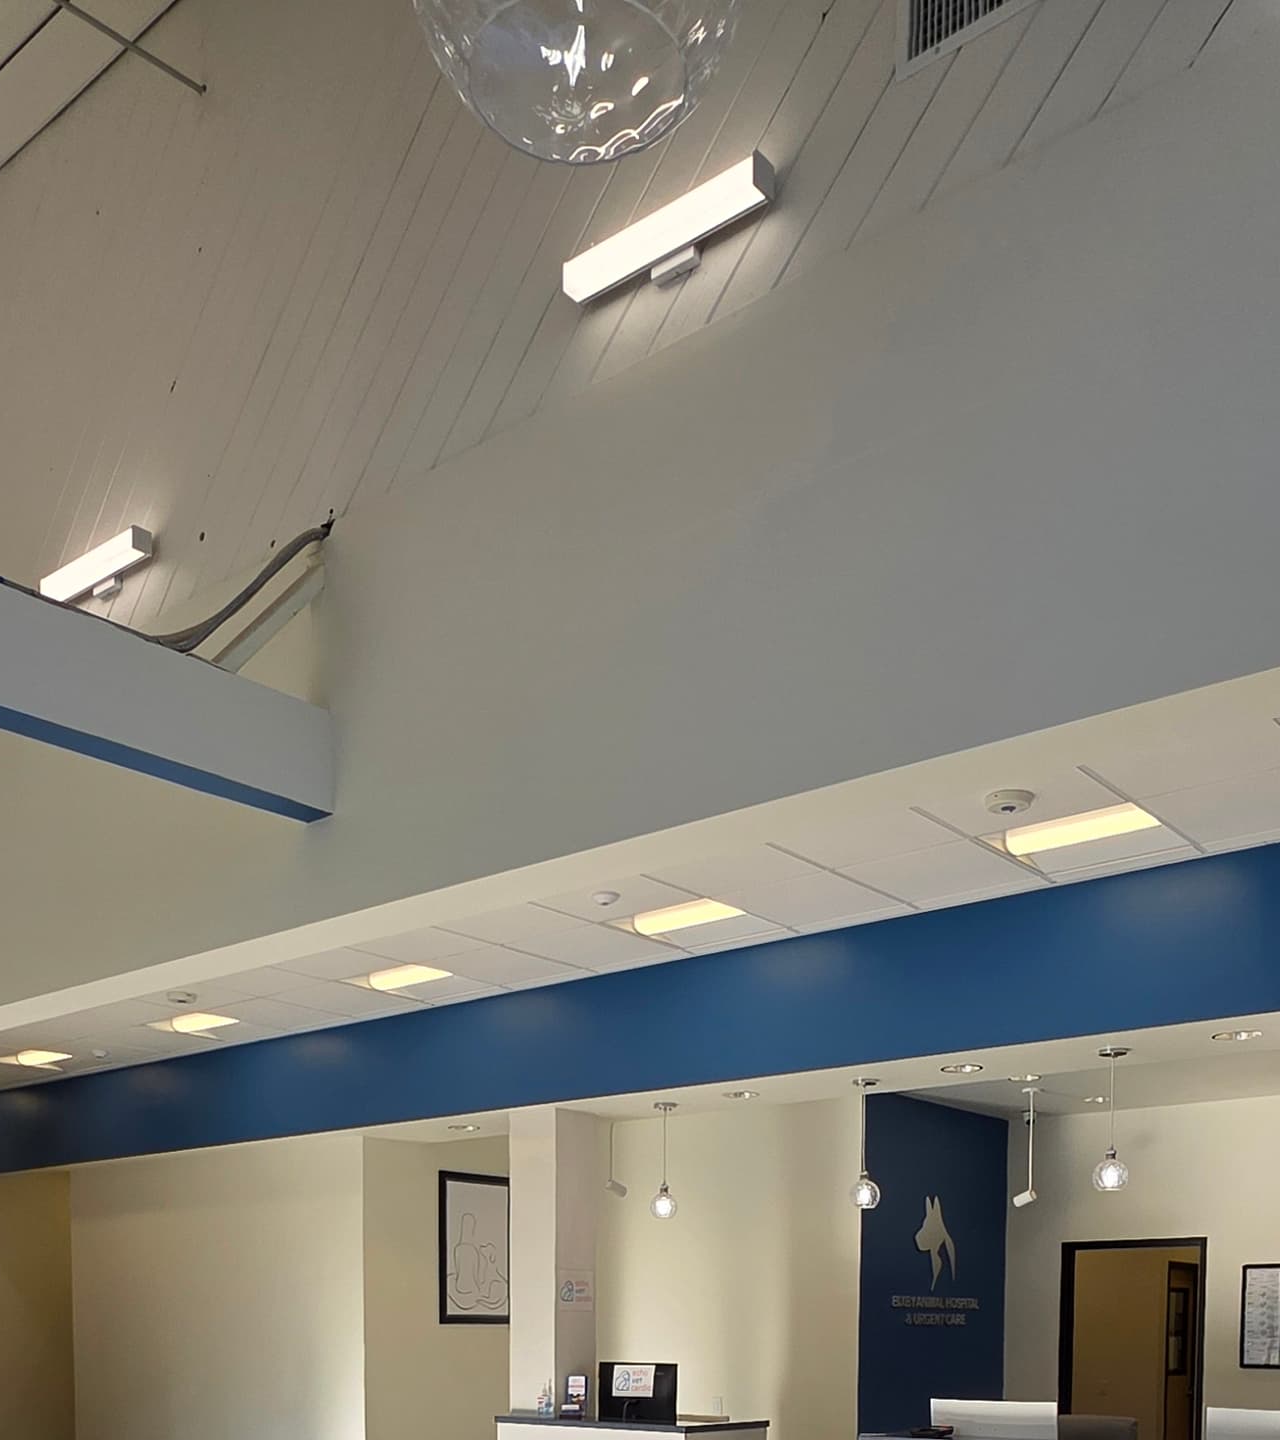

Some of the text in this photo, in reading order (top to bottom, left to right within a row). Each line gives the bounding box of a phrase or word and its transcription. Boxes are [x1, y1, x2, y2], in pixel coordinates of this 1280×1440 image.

[916, 1296, 945, 1309] ANIMAL
[945, 1297, 980, 1310] HOSPITAL
[913, 1313, 944, 1325] URGENT
[945, 1313, 967, 1325] CARE
